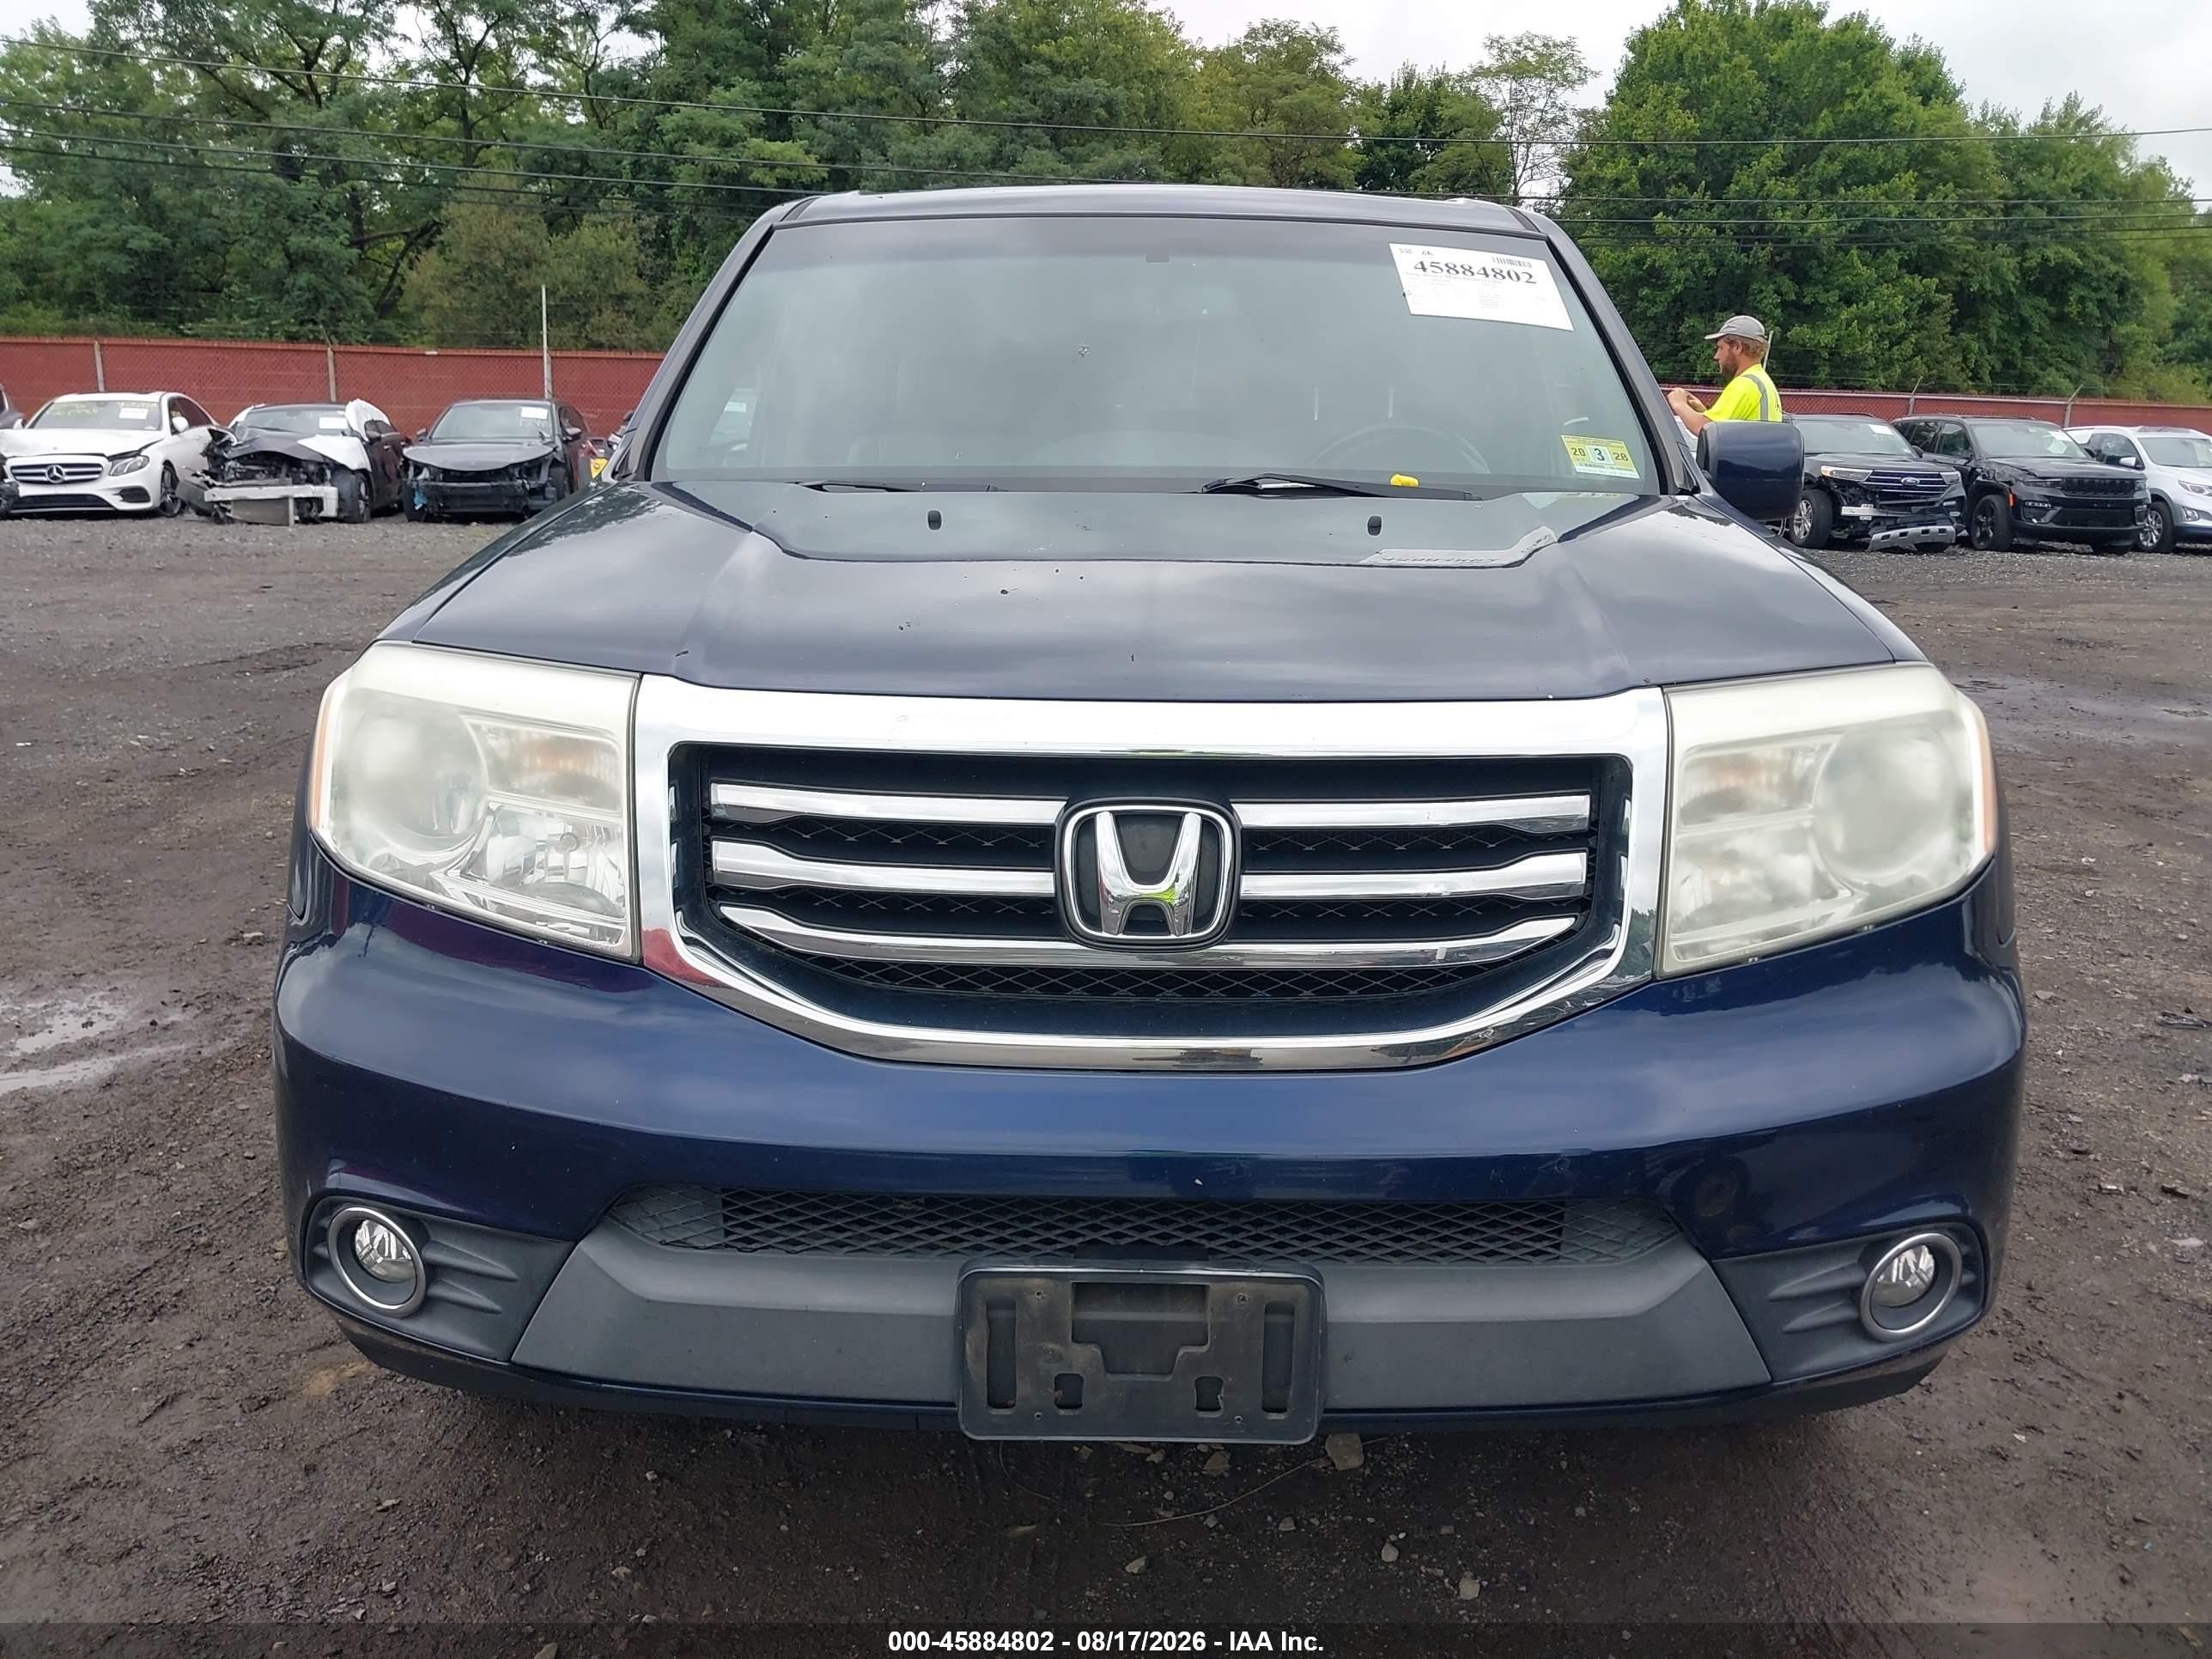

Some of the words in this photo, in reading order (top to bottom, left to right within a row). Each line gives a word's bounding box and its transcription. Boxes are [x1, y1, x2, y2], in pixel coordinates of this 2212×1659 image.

[1413, 260, 1537, 284] 45884802
[1571, 447, 1586, 457] 20
[1594, 447, 1605, 461] 3
[1613, 453, 1628, 462] 28
